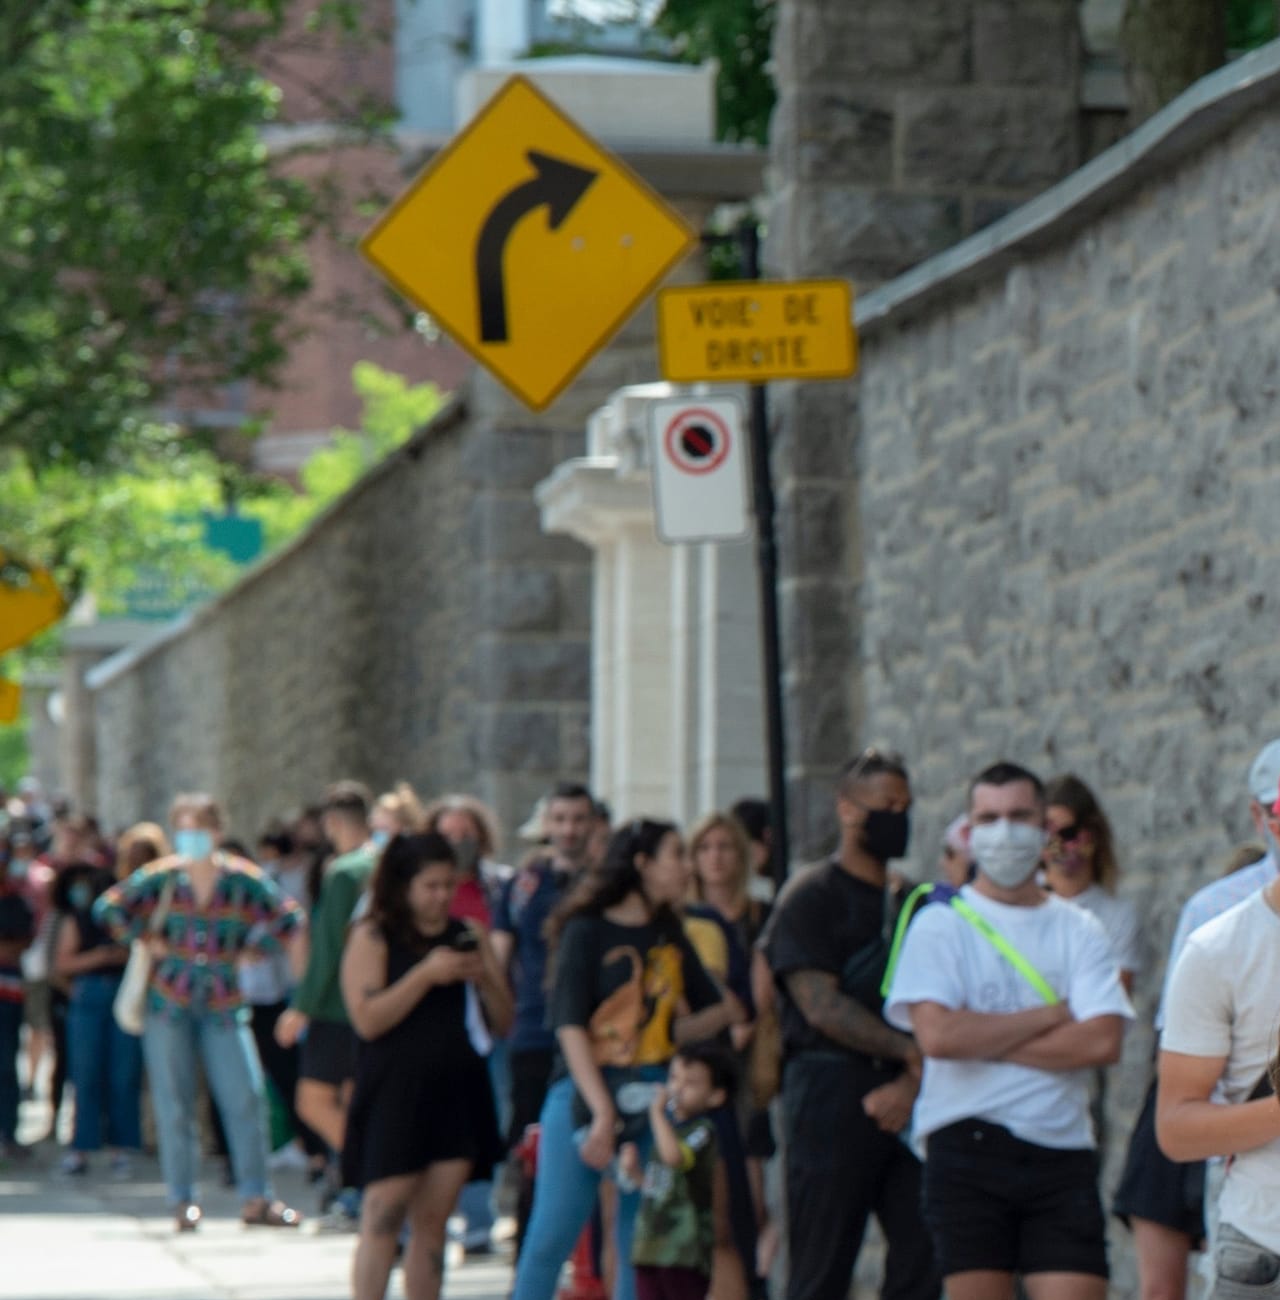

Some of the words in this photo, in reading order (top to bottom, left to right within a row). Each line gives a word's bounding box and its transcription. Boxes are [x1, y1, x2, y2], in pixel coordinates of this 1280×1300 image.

[688, 298, 752, 328] VOIE
[784, 294, 819, 326] DE
[707, 336, 806, 370] DROITE
